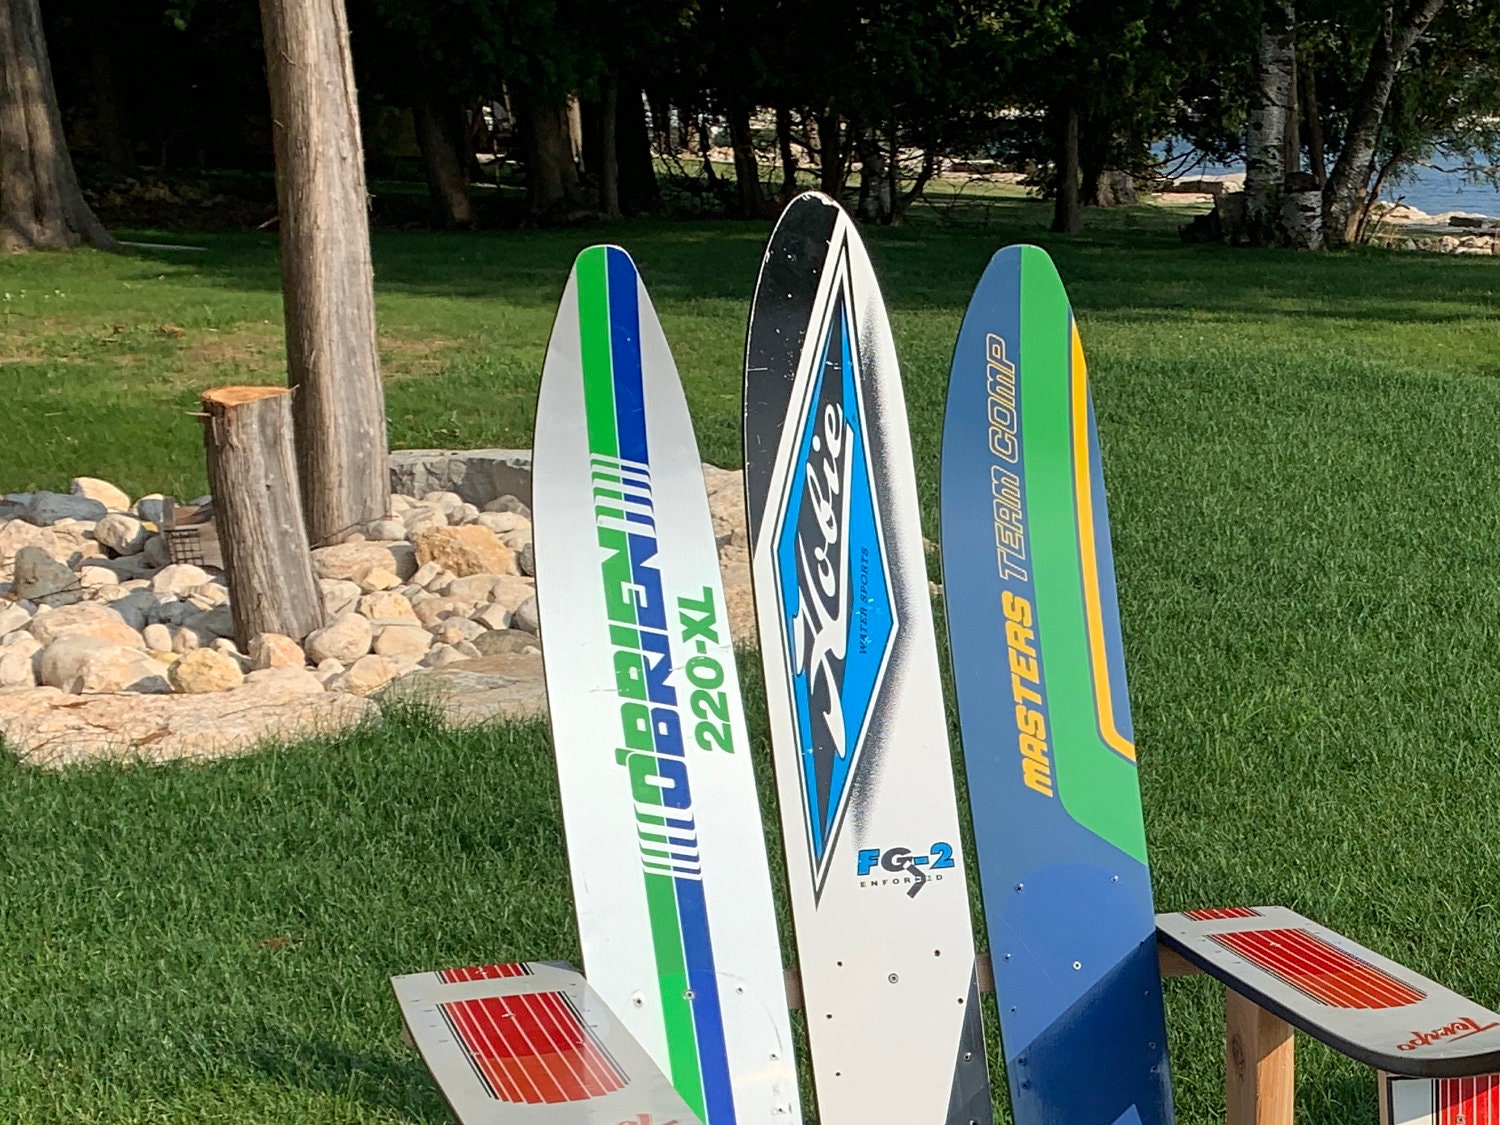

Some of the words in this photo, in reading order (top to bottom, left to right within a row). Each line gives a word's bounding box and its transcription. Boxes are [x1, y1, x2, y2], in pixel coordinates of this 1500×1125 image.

[986, 333, 1018, 462] COMP
[793, 403, 854, 758] Hobie
[860, 547, 871, 604] SPORTS
[991, 467, 1028, 582] TEAM
[596, 525, 692, 810] O'BRIEN
[677, 586, 735, 754] 220-XL
[859, 608, 870, 655] WATER
[1002, 590, 1053, 798] MASTERS
[860, 875, 943, 888] ENFORD
[1397, 1016, 1500, 1051] Tempo
